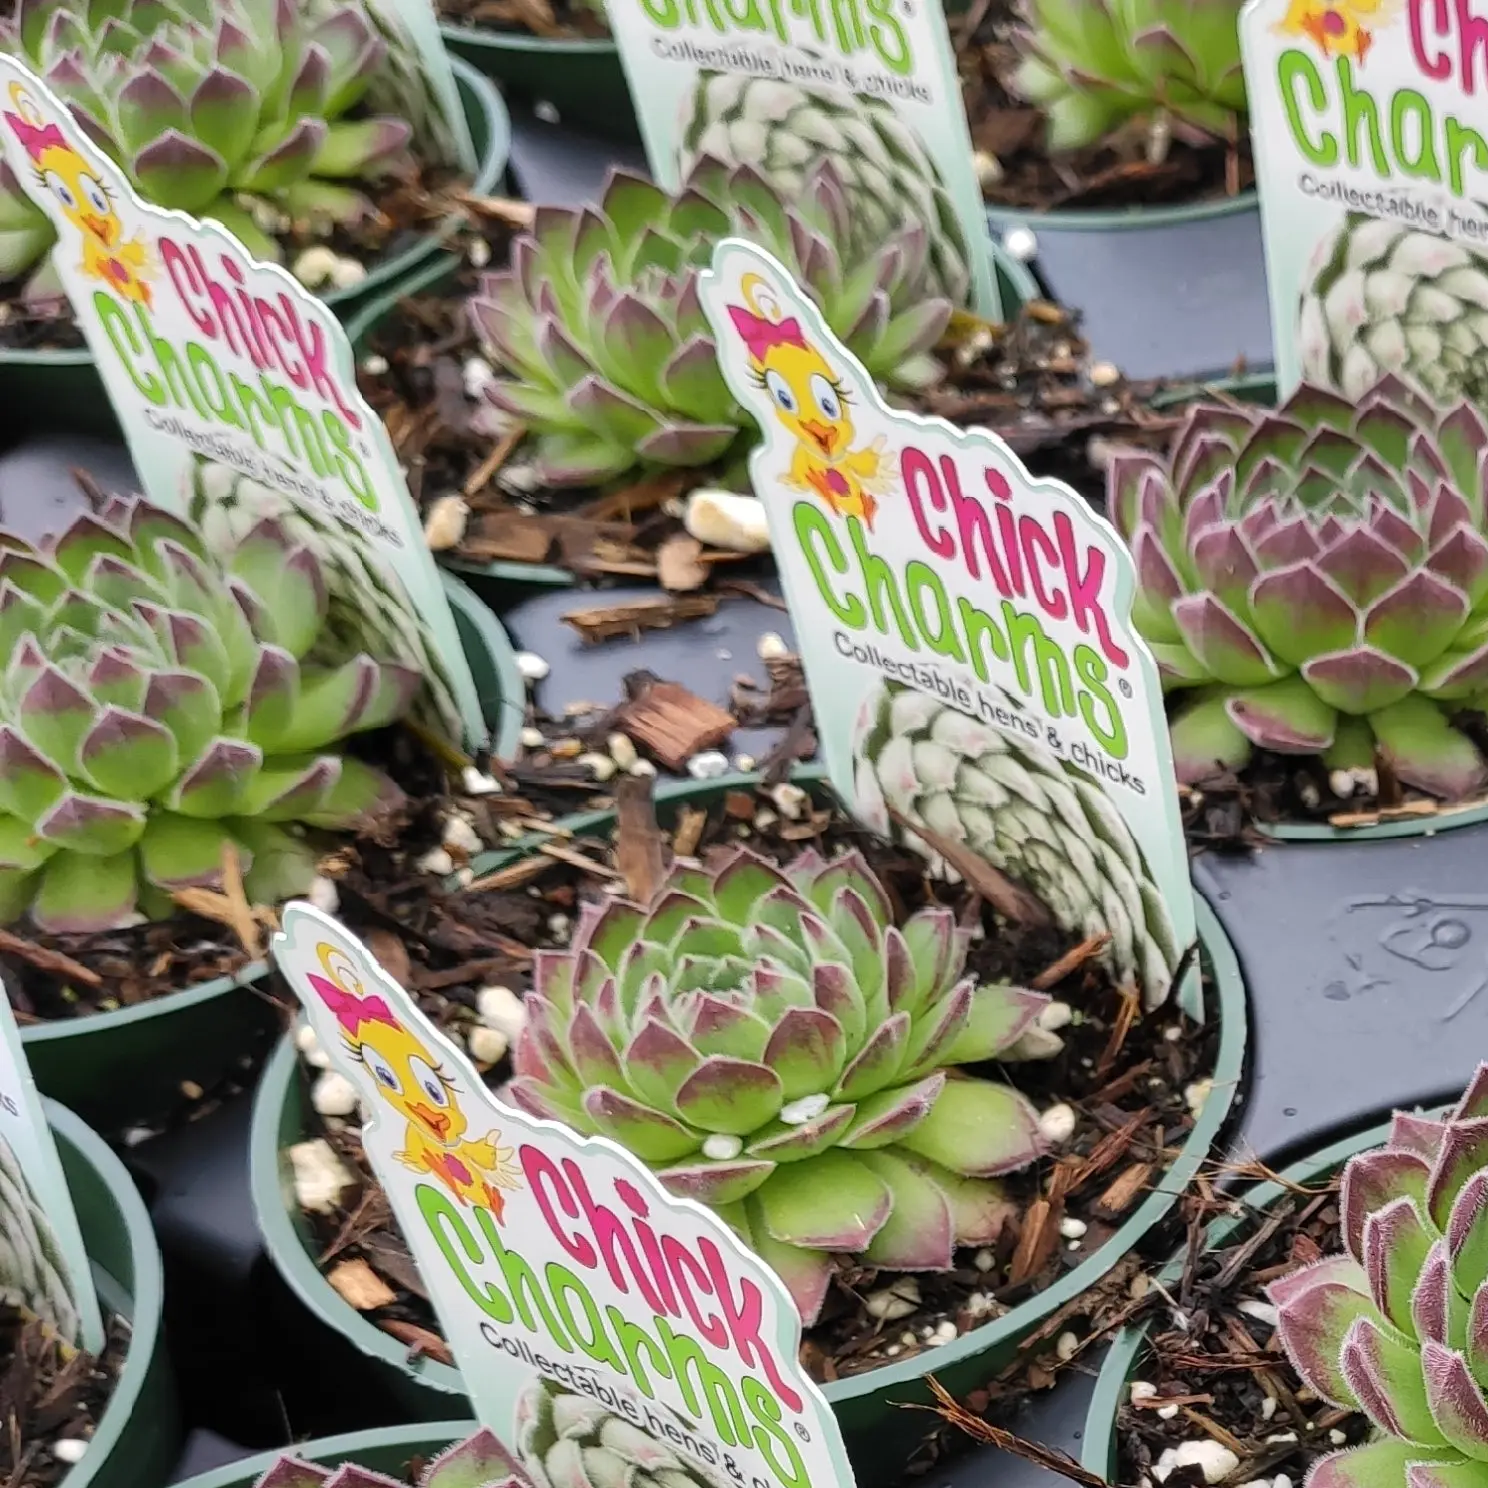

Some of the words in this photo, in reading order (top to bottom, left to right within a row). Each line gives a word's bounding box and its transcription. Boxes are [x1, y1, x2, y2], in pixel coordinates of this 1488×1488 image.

[94, 290, 379, 513] Charms
[159, 236, 362, 430] Chick
[792, 501, 1128, 759] Charms
[900, 446, 1130, 669] Chick
[832, 630, 973, 709] Collectable
[976, 688, 1040, 740] hens
[1046, 724, 1063, 751] &
[1070, 741, 1147, 796] chicks
[518, 1143, 804, 1413] Chick
[478, 1321, 639, 1420] Collectable
[648, 1412, 718, 1465] hens
[723, 1452, 745, 1485] &
